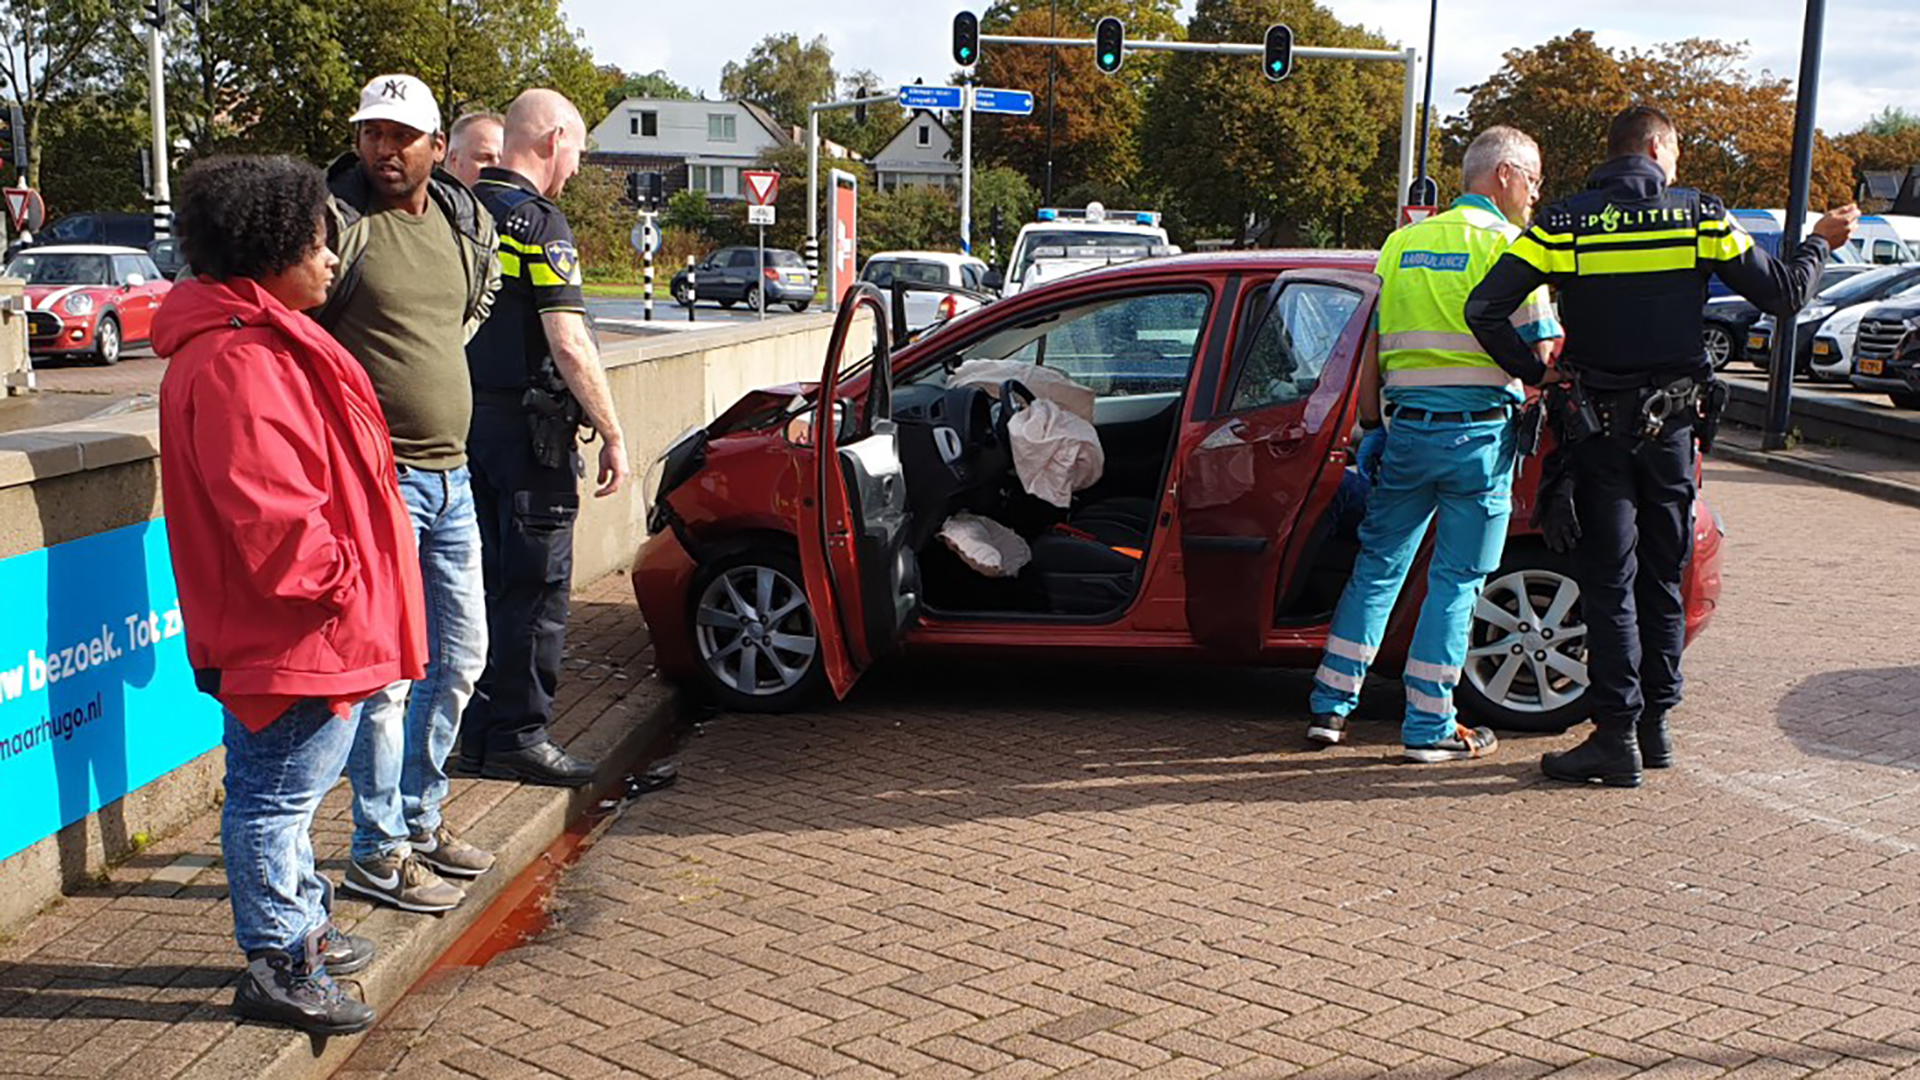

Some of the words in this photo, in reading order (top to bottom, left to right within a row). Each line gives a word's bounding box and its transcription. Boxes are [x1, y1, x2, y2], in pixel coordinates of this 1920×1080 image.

[381, 79, 407, 101] NY
[1588, 203, 1684, 231] POLITIE
[1400, 252, 1467, 269] AMBULANCE
[28, 623, 122, 691] bezoek.
[125, 610, 160, 650] Tot
